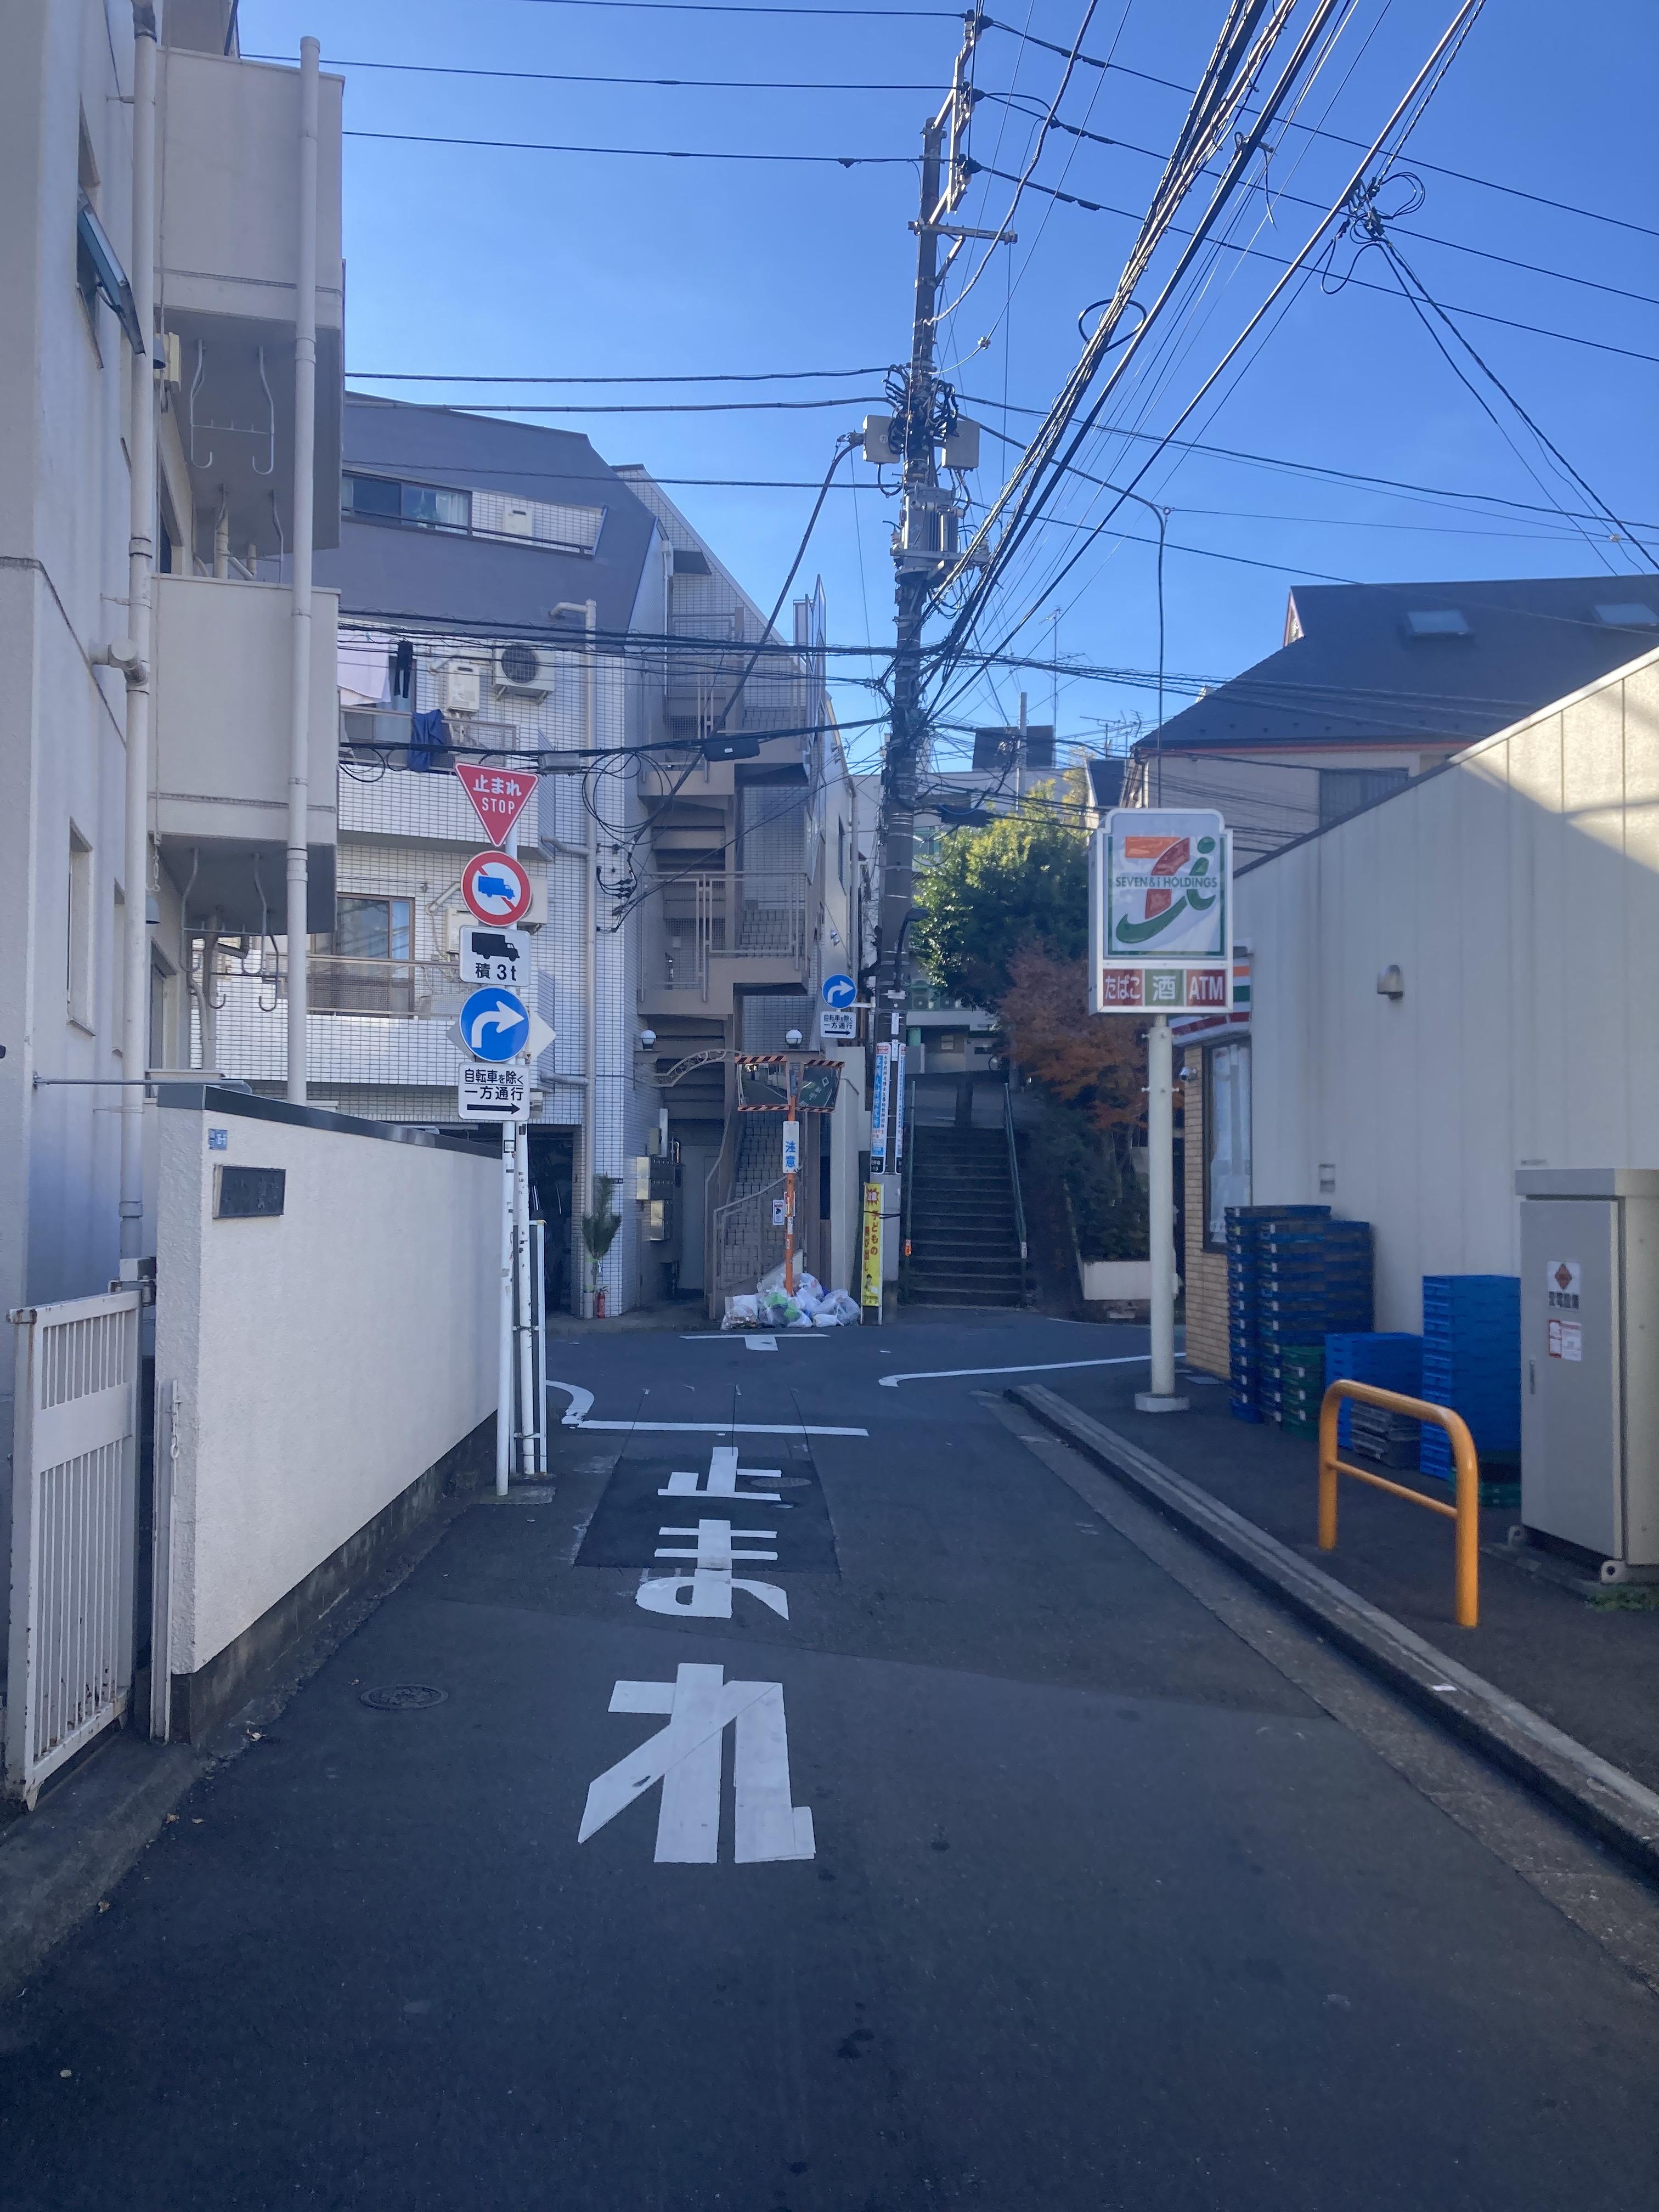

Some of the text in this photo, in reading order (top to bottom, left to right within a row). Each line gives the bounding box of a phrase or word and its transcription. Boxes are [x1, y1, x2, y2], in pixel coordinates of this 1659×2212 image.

[473, 774, 522, 796] 止まれ
[482, 797, 515, 815] STOP
[1163, 877, 1217, 888] HOLDINGS
[1104, 975, 1142, 1000] たばこ
[1152, 975, 1177, 1001] 酒
[1189, 975, 1224, 1001] ATM
[465, 1068, 523, 1085] 自転車を除く
[464, 1086, 524, 1101] 一方通行
[785, 1141, 796, 1168] 注意
[870, 1210, 879, 1255] 子どもの
[578, 1447, 816, 1864] 止まれ
